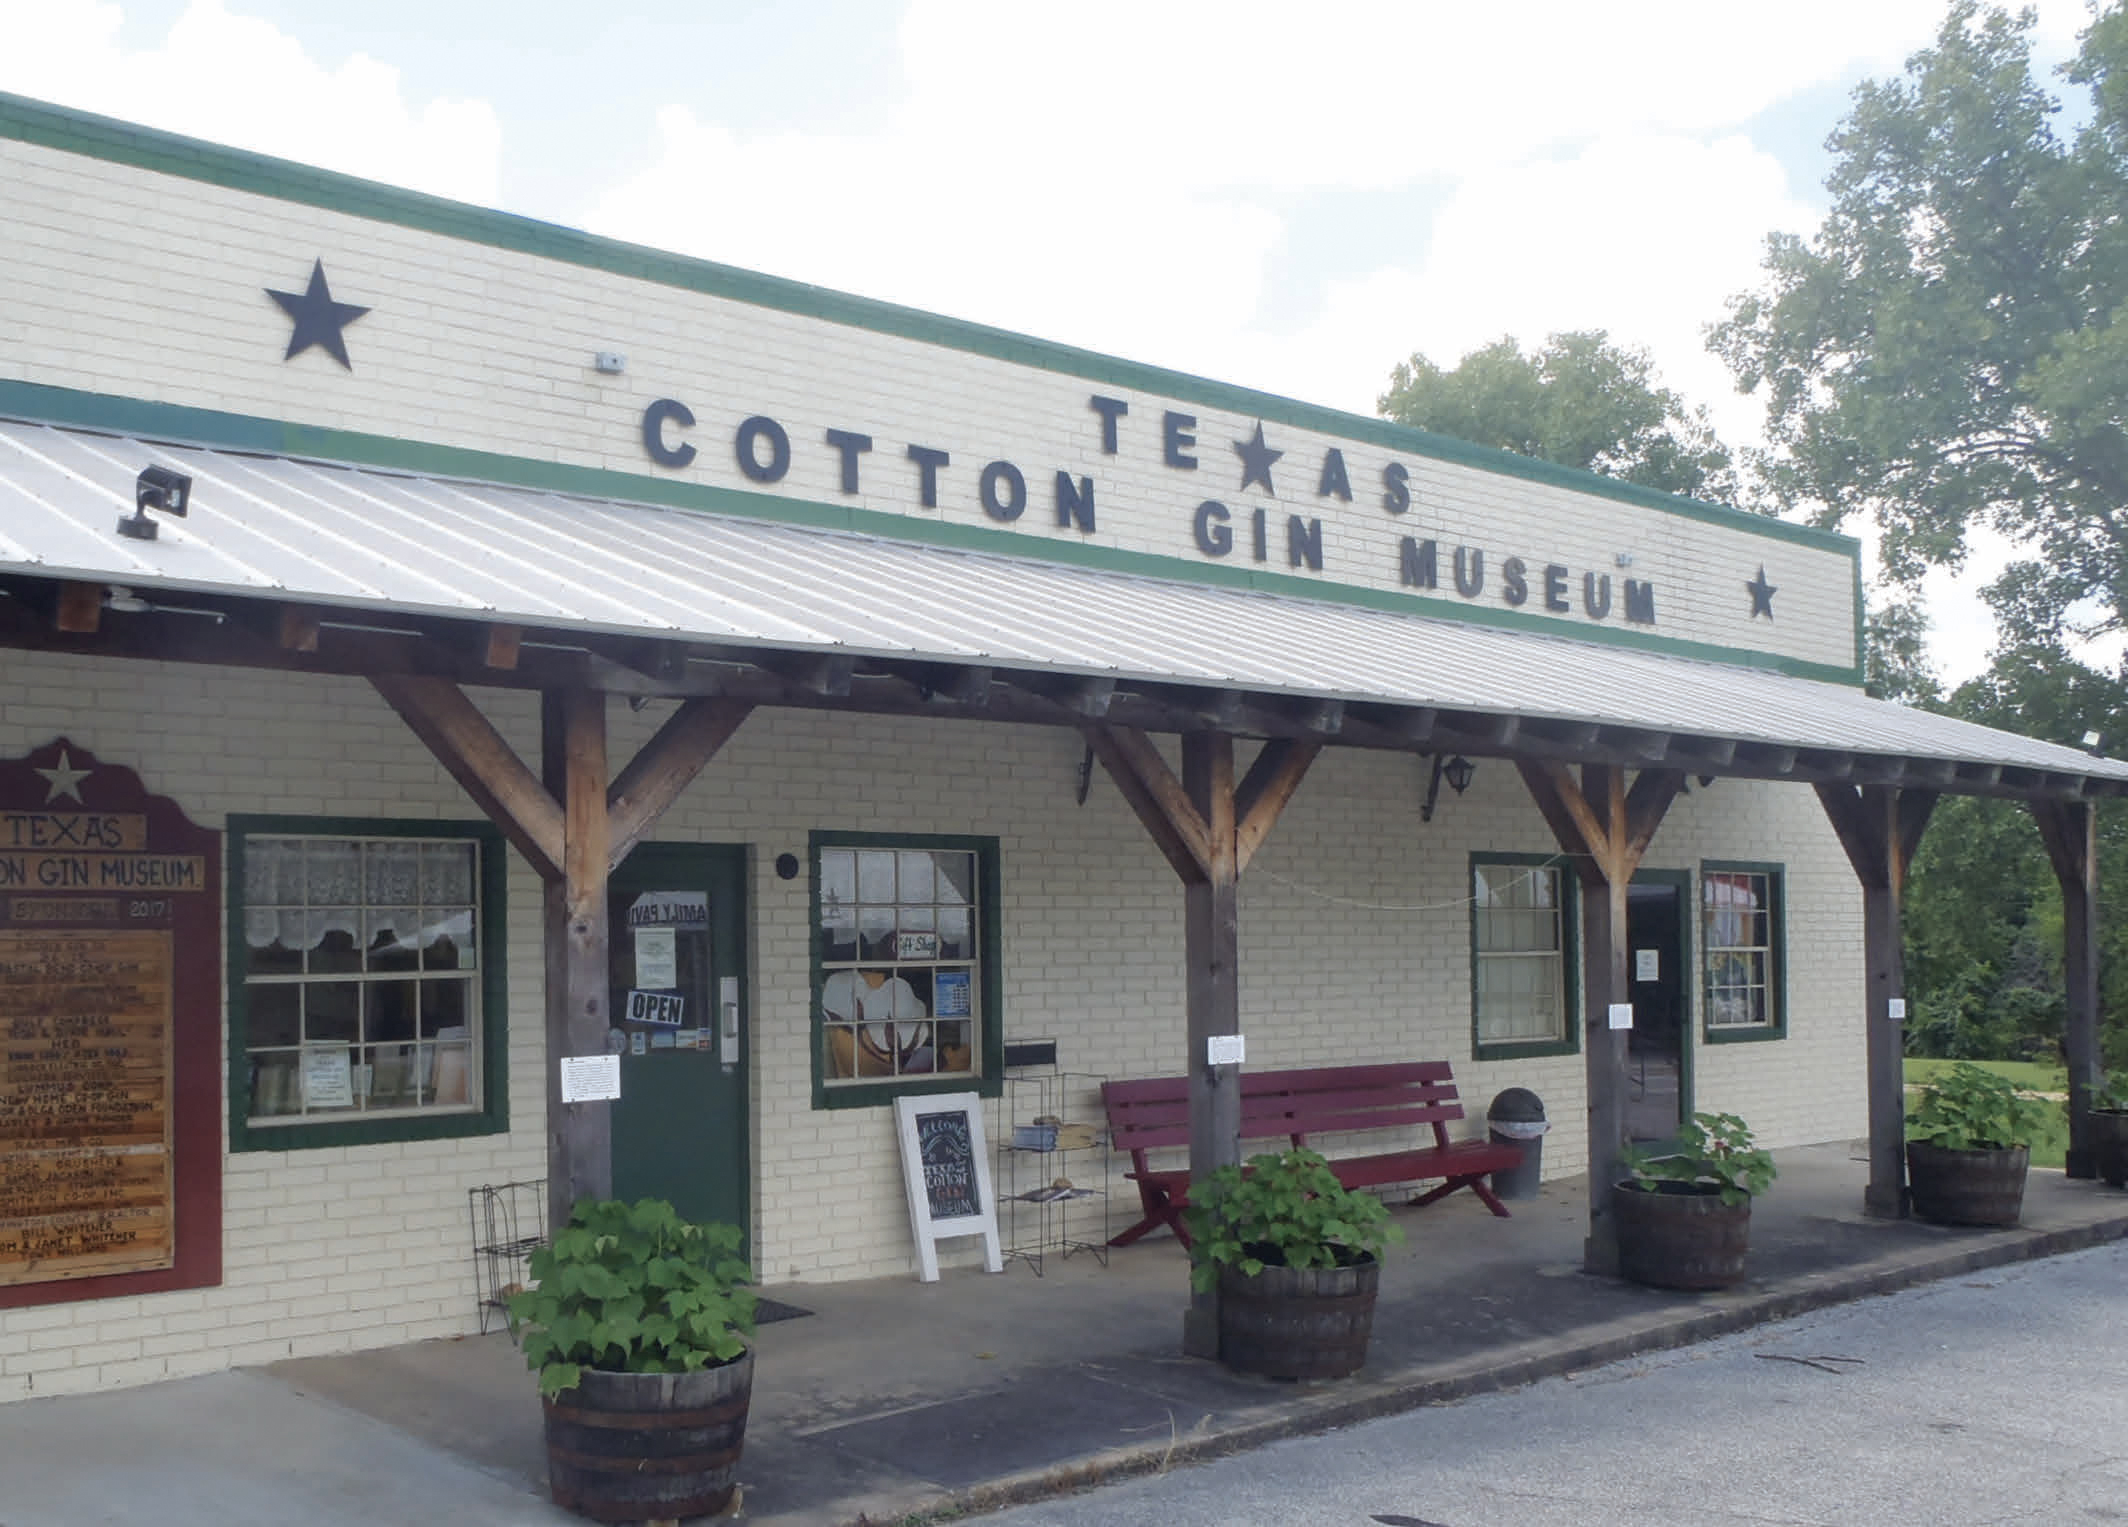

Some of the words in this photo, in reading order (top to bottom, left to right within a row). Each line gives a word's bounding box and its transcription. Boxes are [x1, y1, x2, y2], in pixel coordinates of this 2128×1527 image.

[643, 398, 1096, 534] COTTON
[1193, 500, 1324, 571] GIN
[1401, 535, 1657, 626] MUSEUM
[5, 814, 122, 848] TEXAS
[38, 857, 90, 887] GIN
[632, 993, 681, 1023] OPEN
